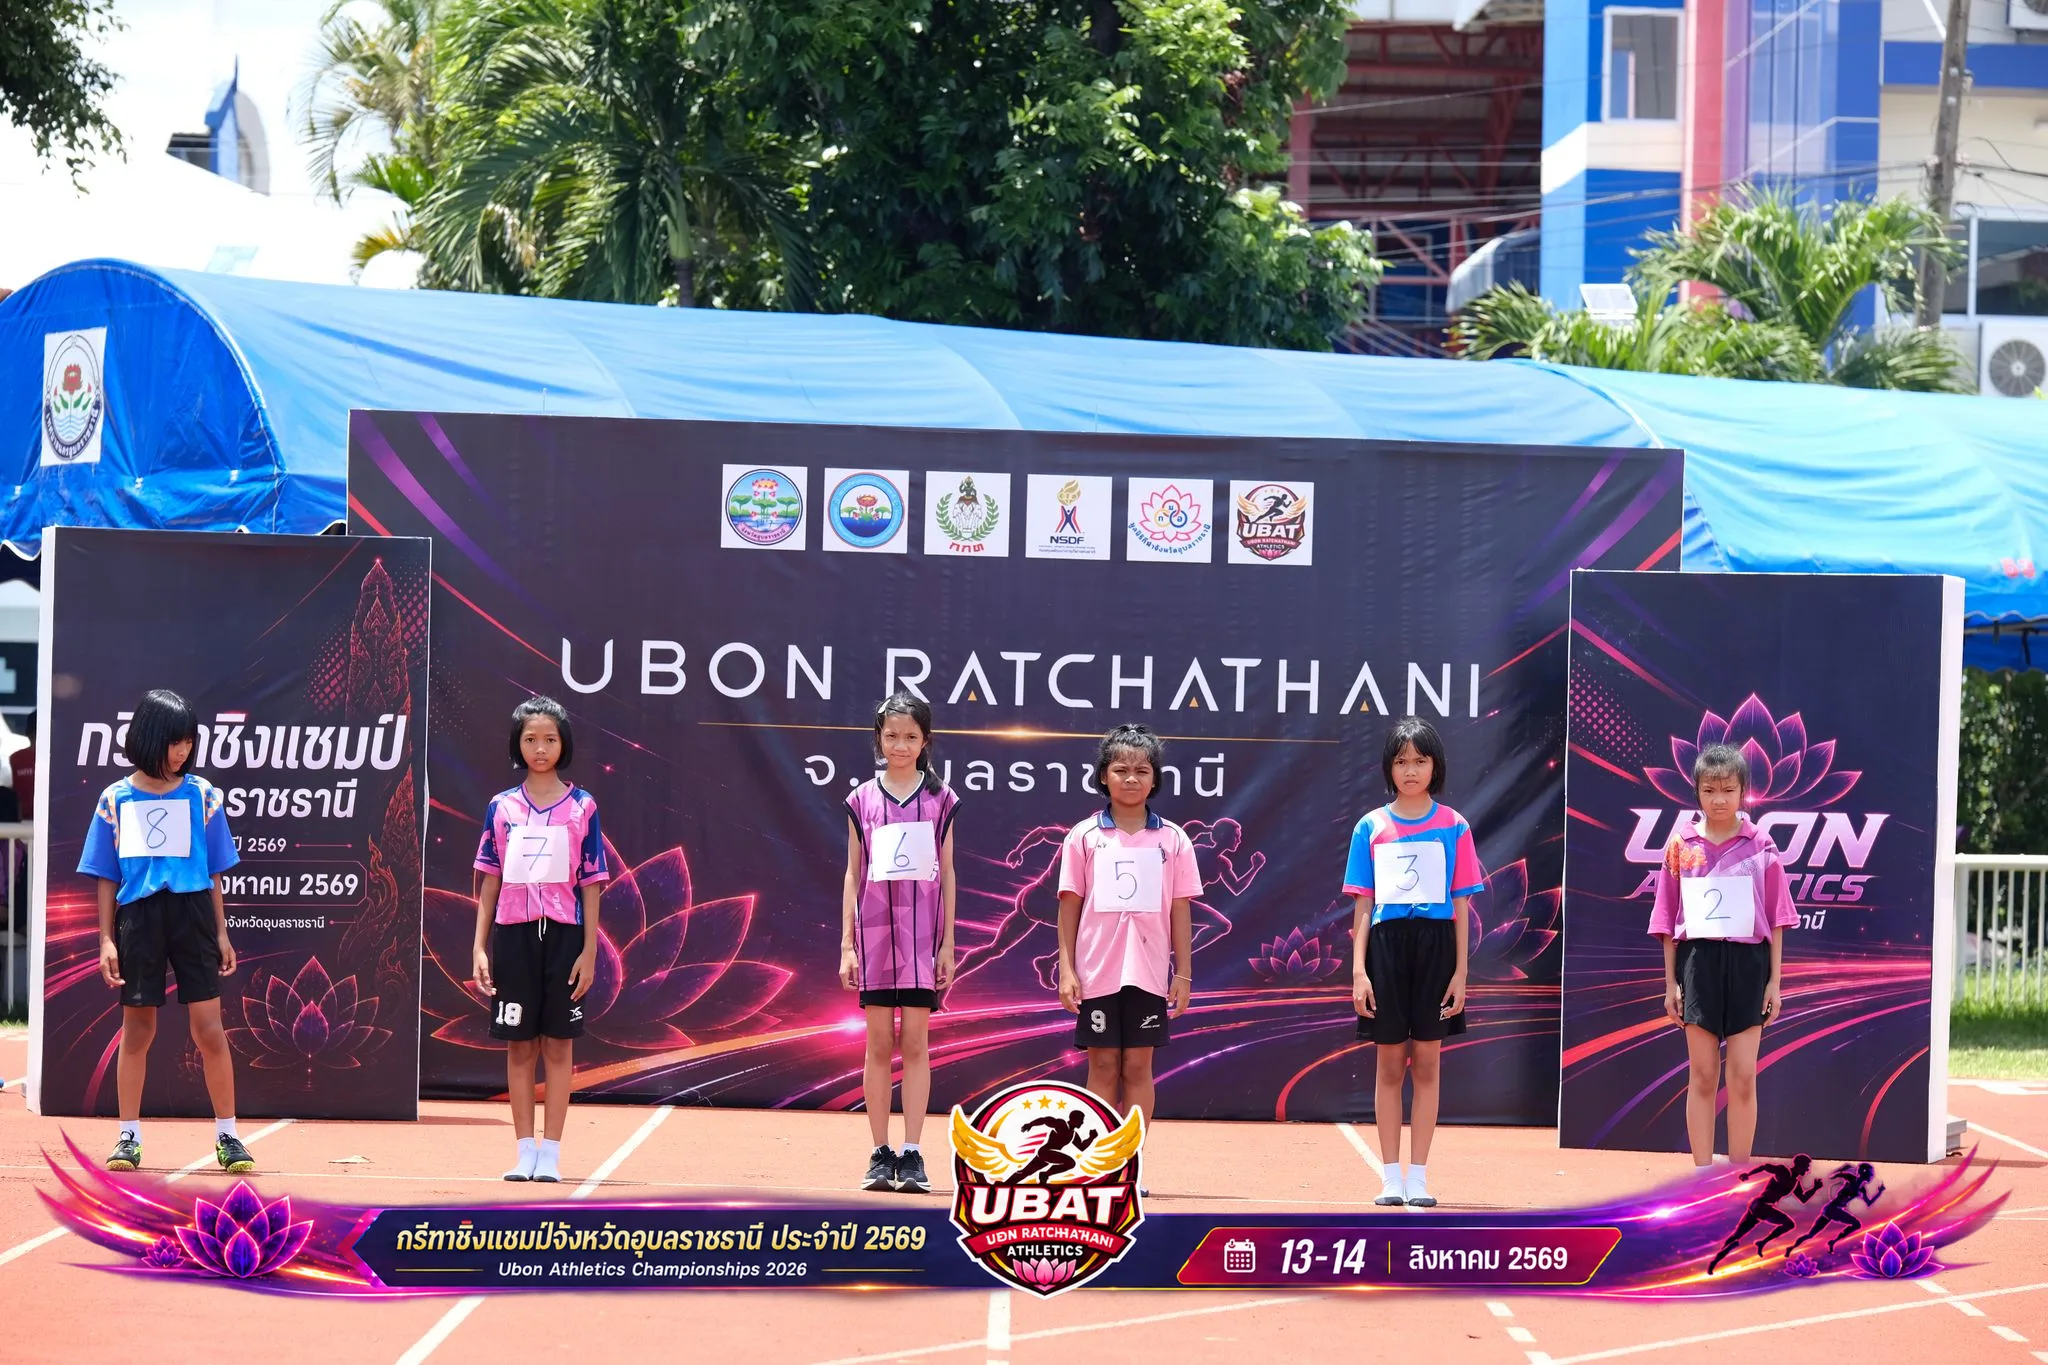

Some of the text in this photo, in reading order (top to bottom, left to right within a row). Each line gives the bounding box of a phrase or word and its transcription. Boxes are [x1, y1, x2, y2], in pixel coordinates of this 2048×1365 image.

[1049, 535, 1085, 545] NSDF
[1242, 522, 1300, 539] UBAT
[561, 637, 1480, 718] UBON RATCHATHANI
[146, 807, 168, 850] 8
[247, 837, 287, 852] 2569
[1624, 808, 1891, 868] UON
[522, 836, 553, 872] 7
[893, 831, 911, 869] 6
[220, 873, 359, 896] งหาคม 2569
[1113, 860, 1138, 900] 5
[1395, 854, 1420, 892] 3
[1703, 888, 1732, 921] 2
[495, 1000, 523, 1027] 18
[1090, 1009, 1107, 1034] 9
